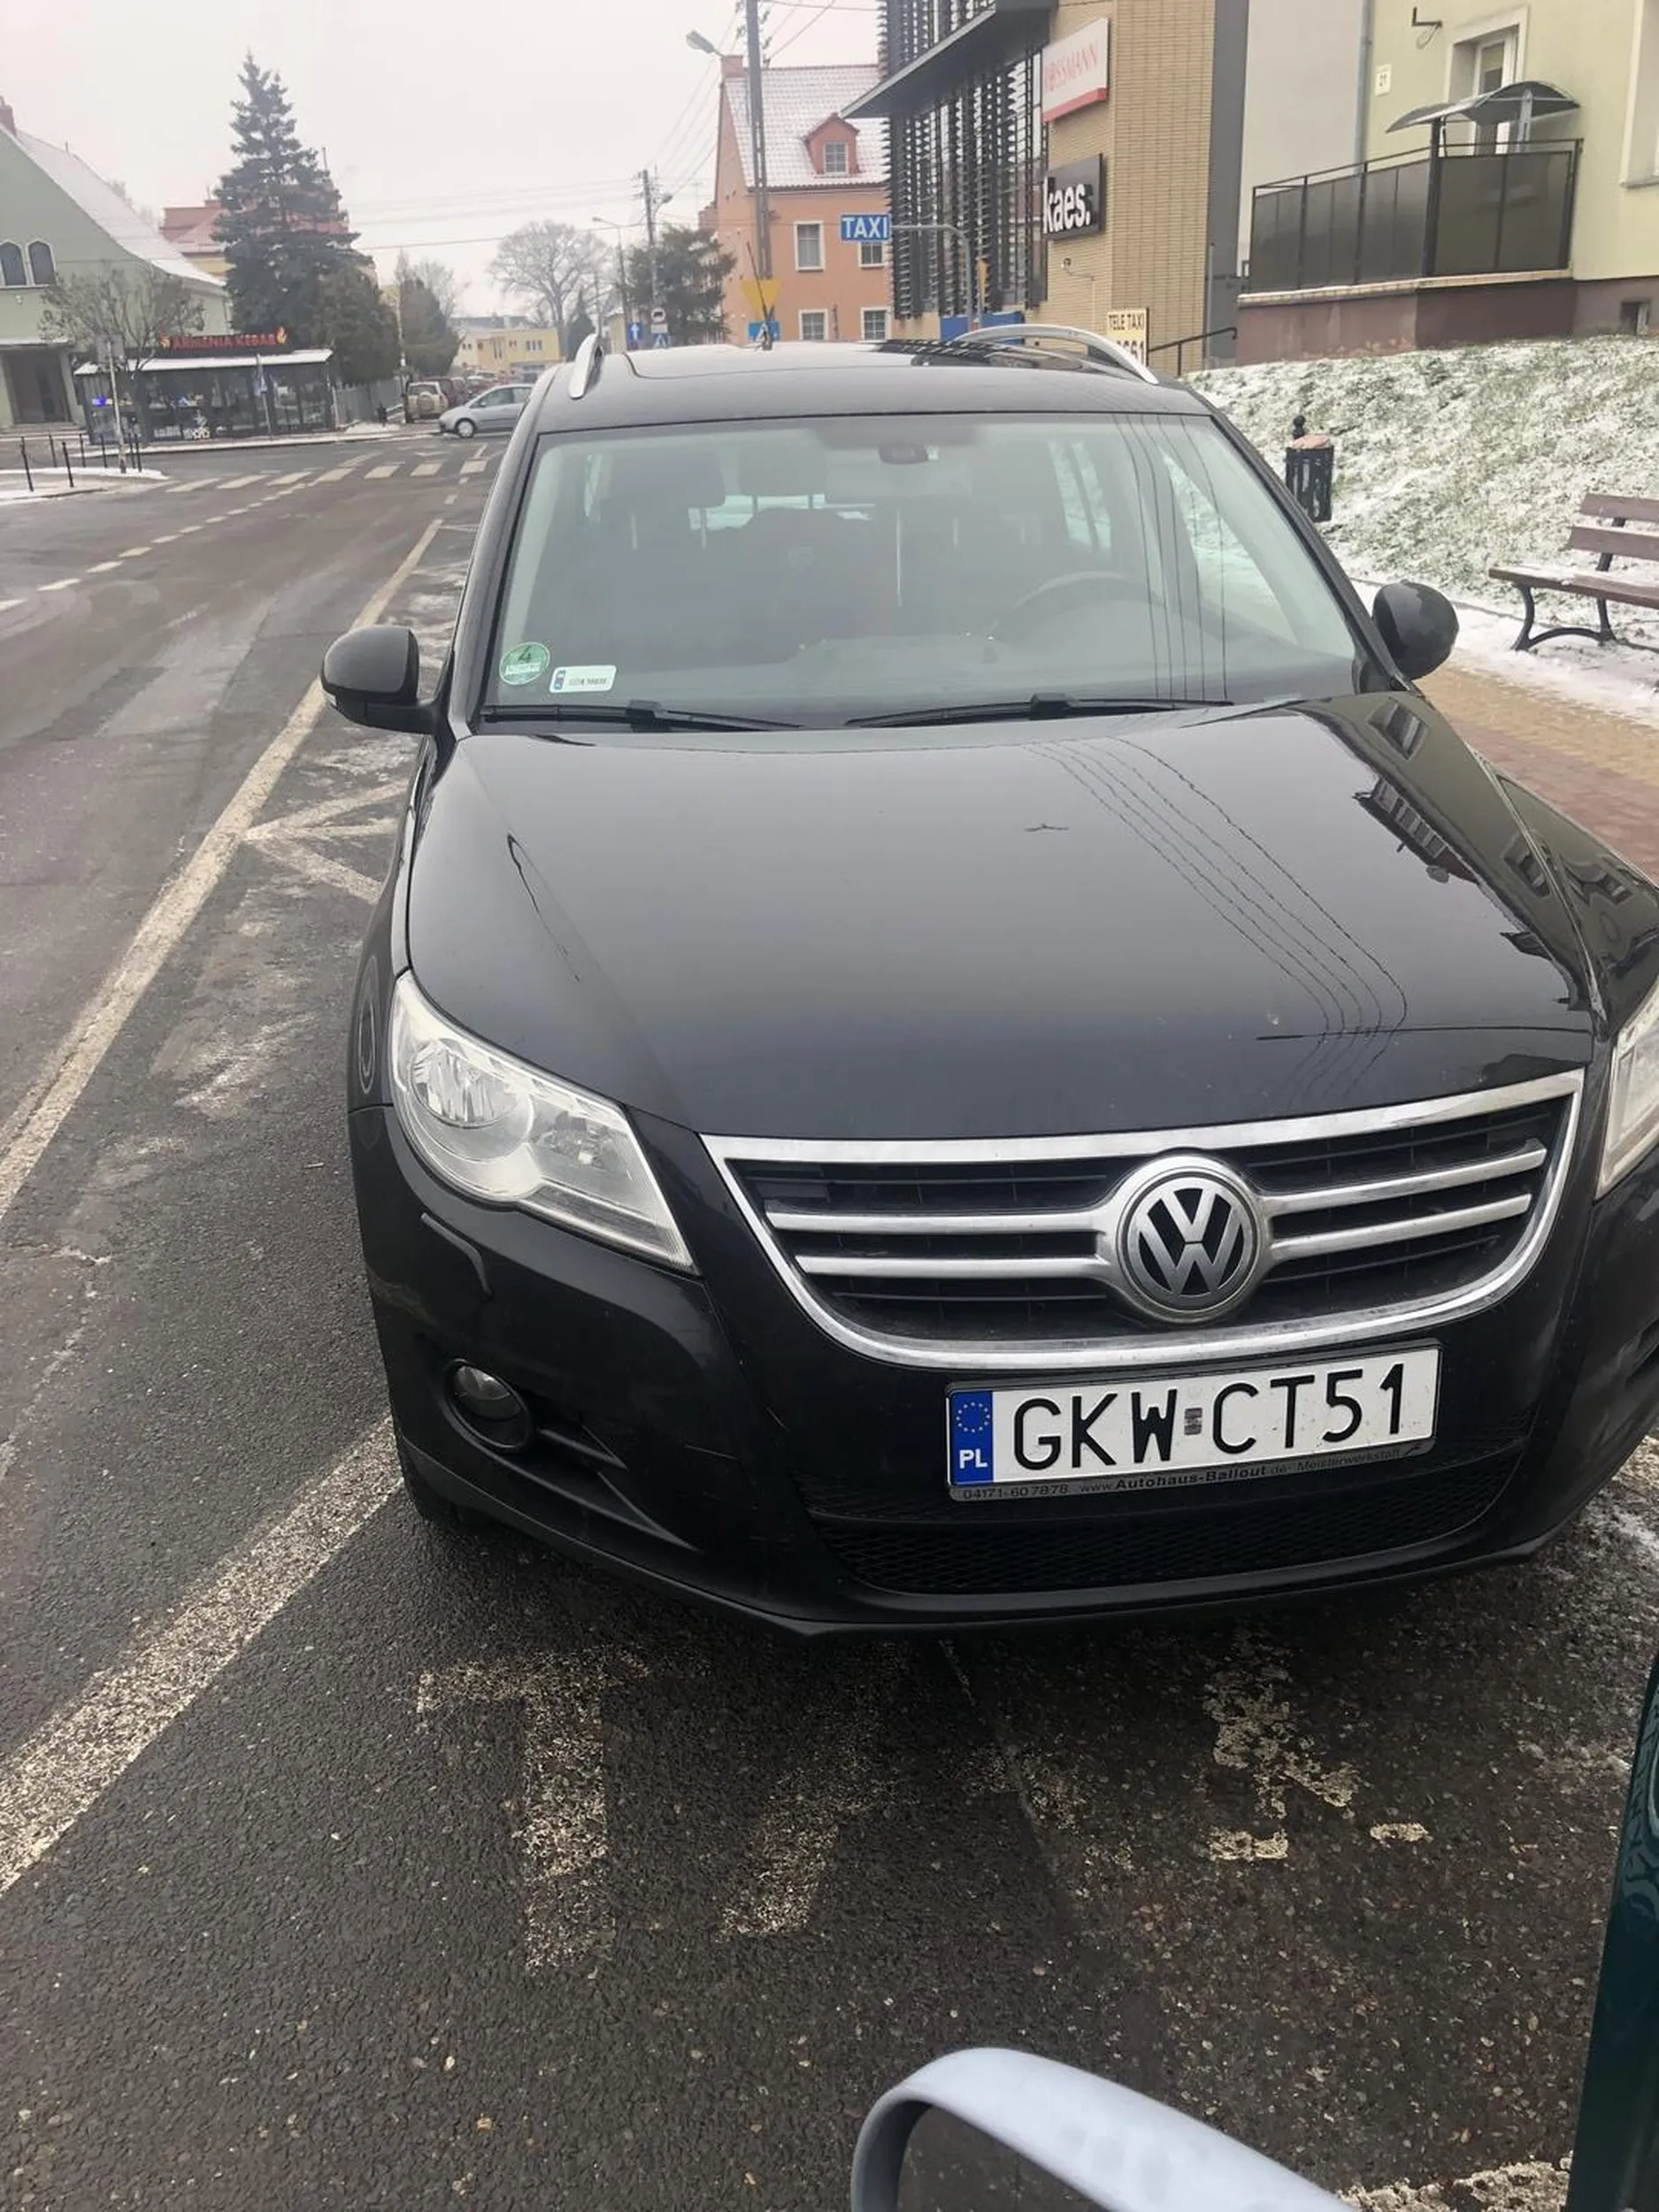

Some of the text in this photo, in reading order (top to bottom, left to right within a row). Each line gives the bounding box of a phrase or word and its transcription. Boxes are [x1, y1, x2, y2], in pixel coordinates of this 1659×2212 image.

[841, 216, 888, 238] TAXI
[1108, 311, 1145, 331] TELE TAXI
[518, 645, 531, 663] 4
[1013, 1363, 1405, 1471] GKW CT51
[959, 1448, 988, 1469] PL
